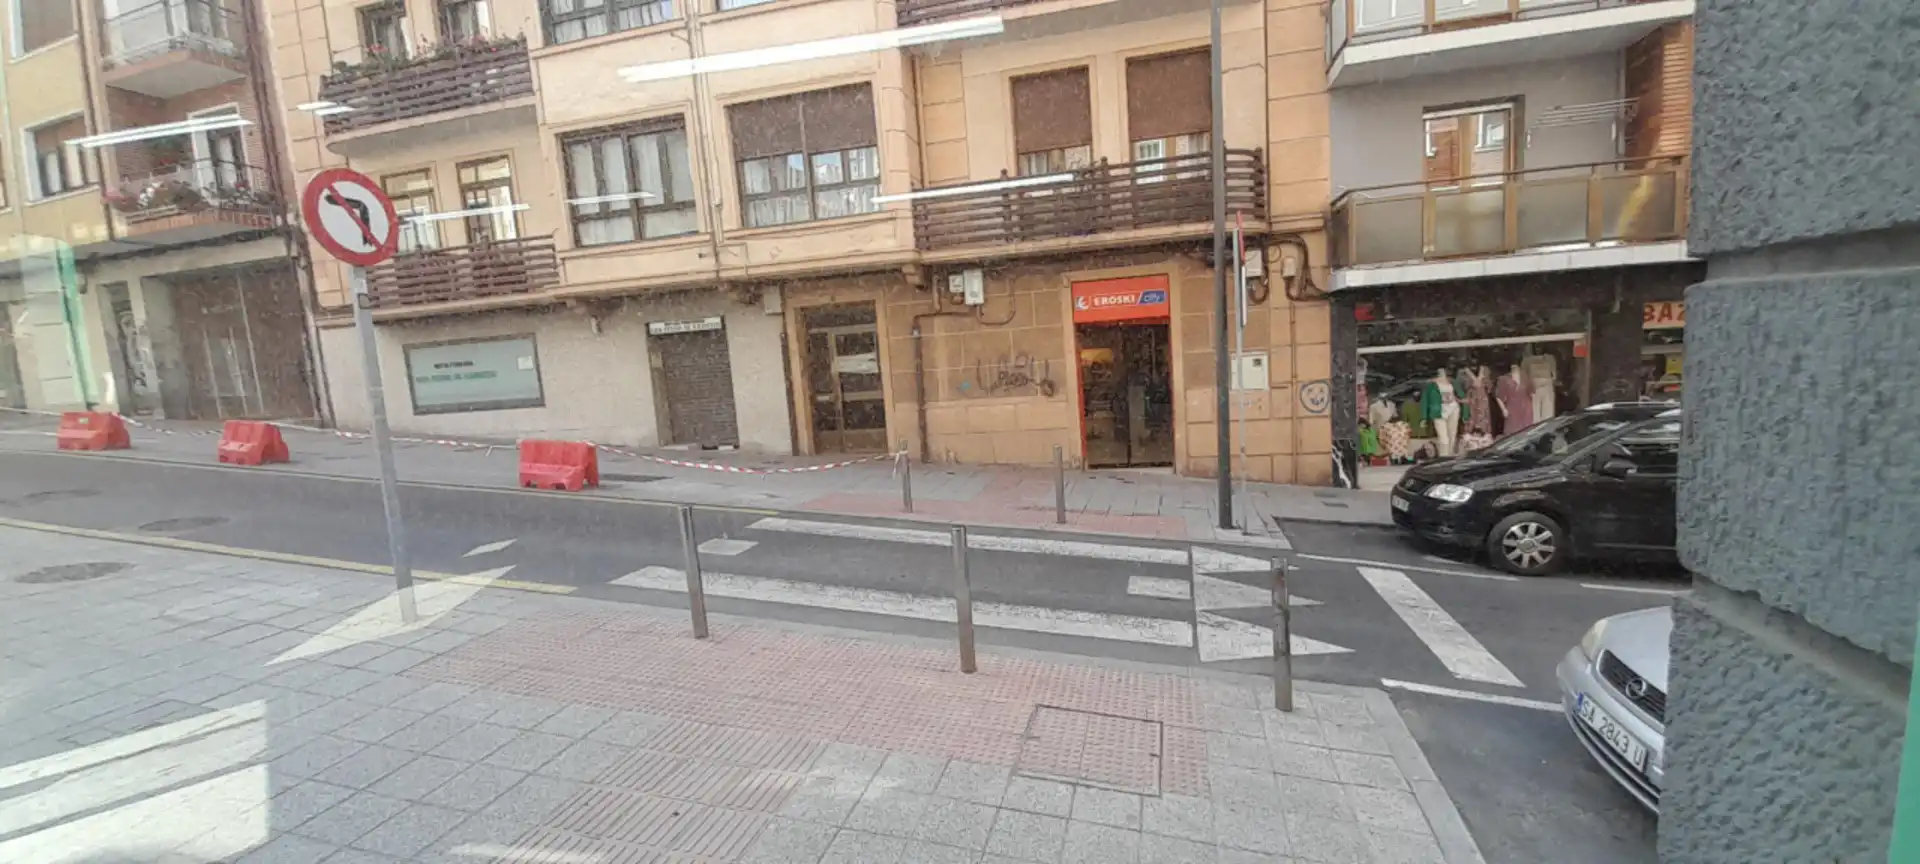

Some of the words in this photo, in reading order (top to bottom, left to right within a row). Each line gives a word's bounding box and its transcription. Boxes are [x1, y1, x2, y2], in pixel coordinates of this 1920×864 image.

[1093, 294, 1136, 306] EROSKI
[1582, 700, 1596, 725] SA
[1599, 715, 1630, 754] 2843
